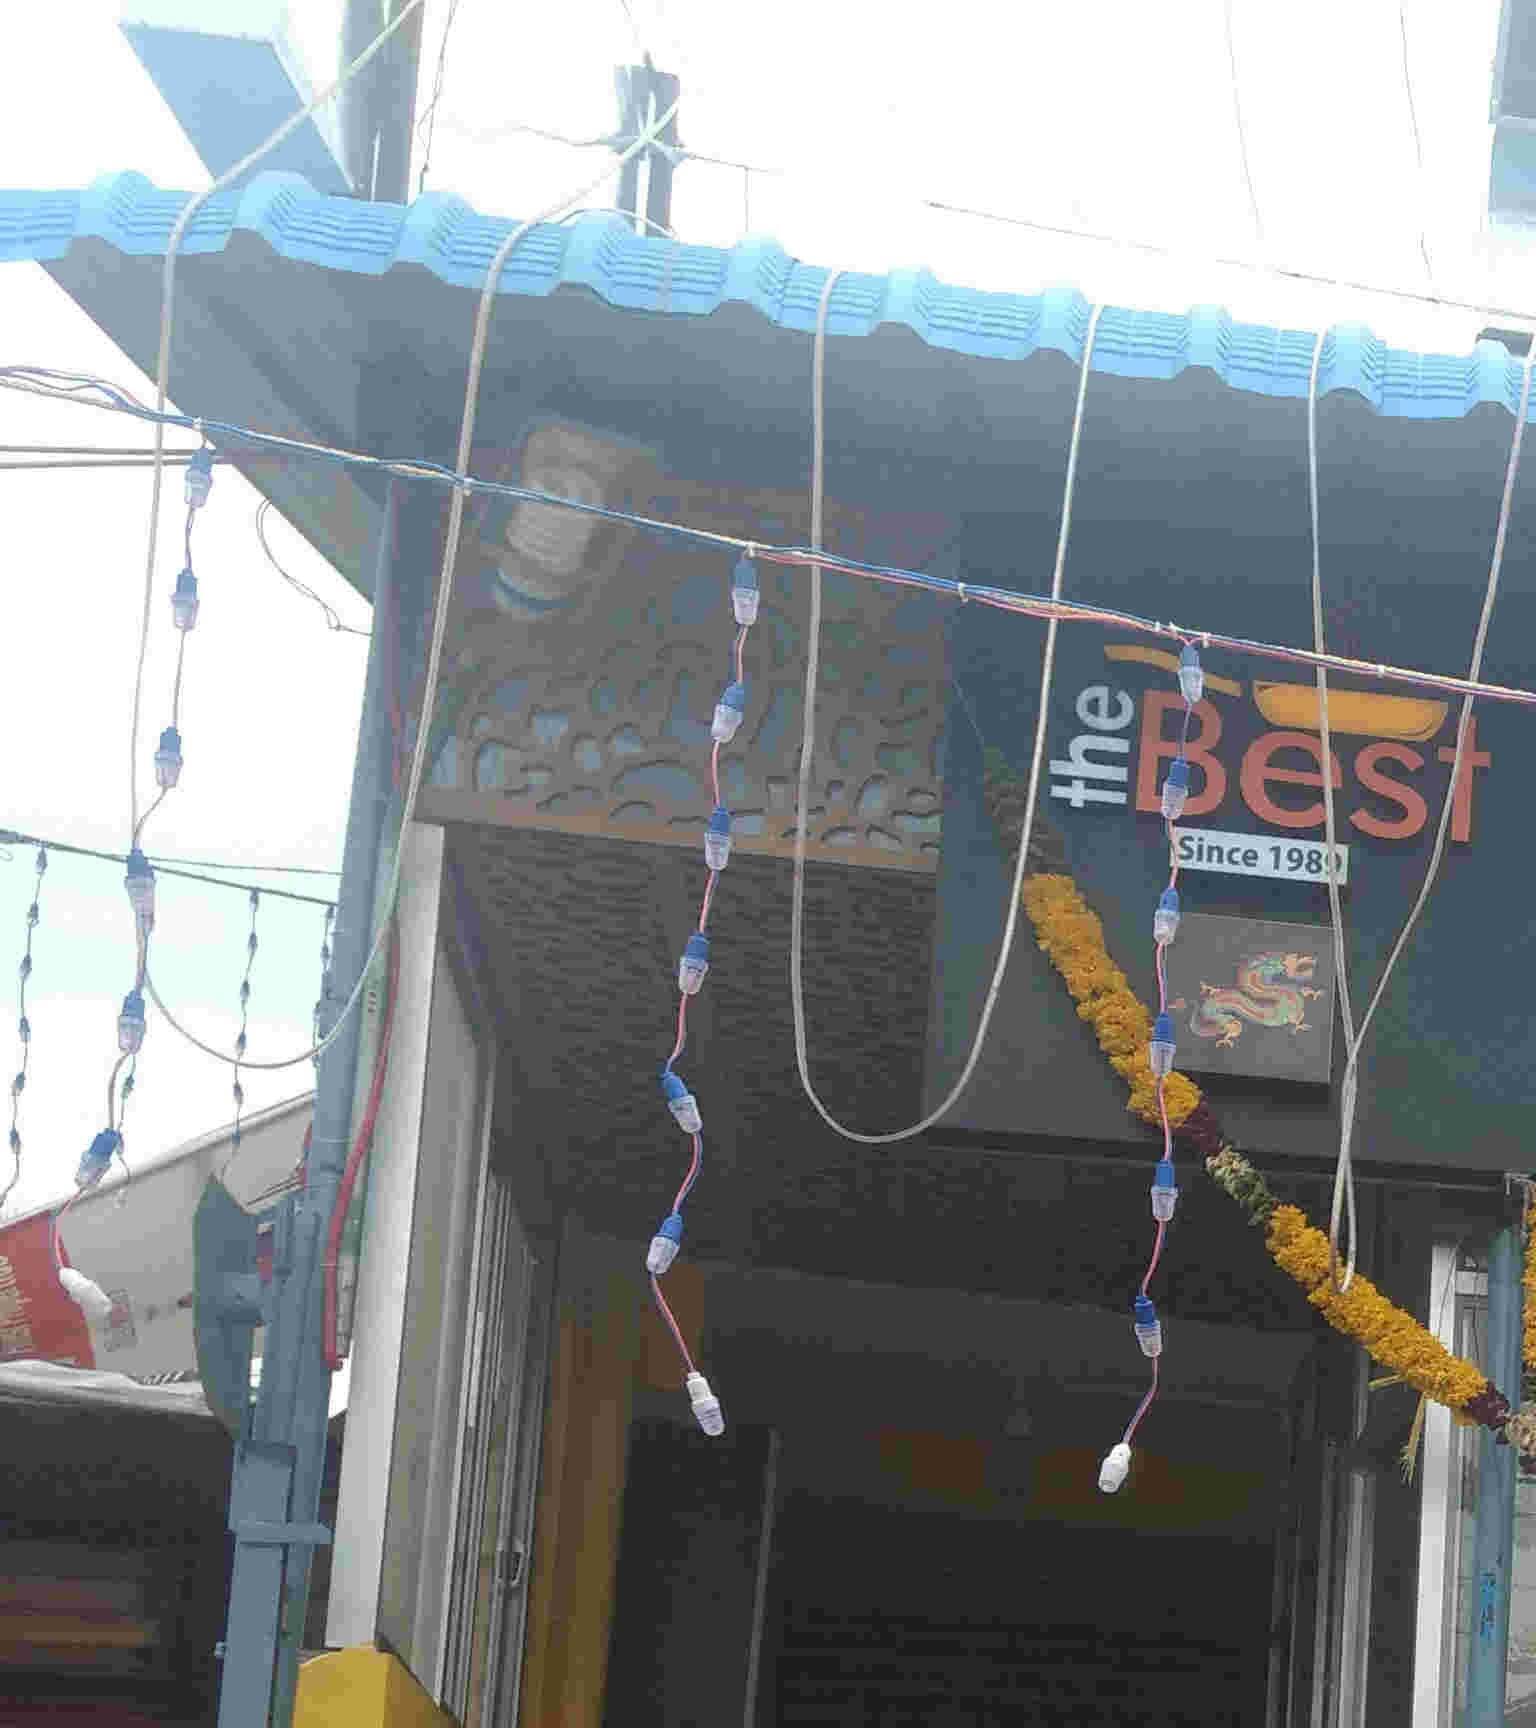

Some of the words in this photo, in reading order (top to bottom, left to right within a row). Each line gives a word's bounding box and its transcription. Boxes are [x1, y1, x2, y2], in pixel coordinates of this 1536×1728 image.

[1049, 683, 1135, 810] the
[1134, 688, 1493, 844] Best
[1177, 834, 1260, 870] Since
